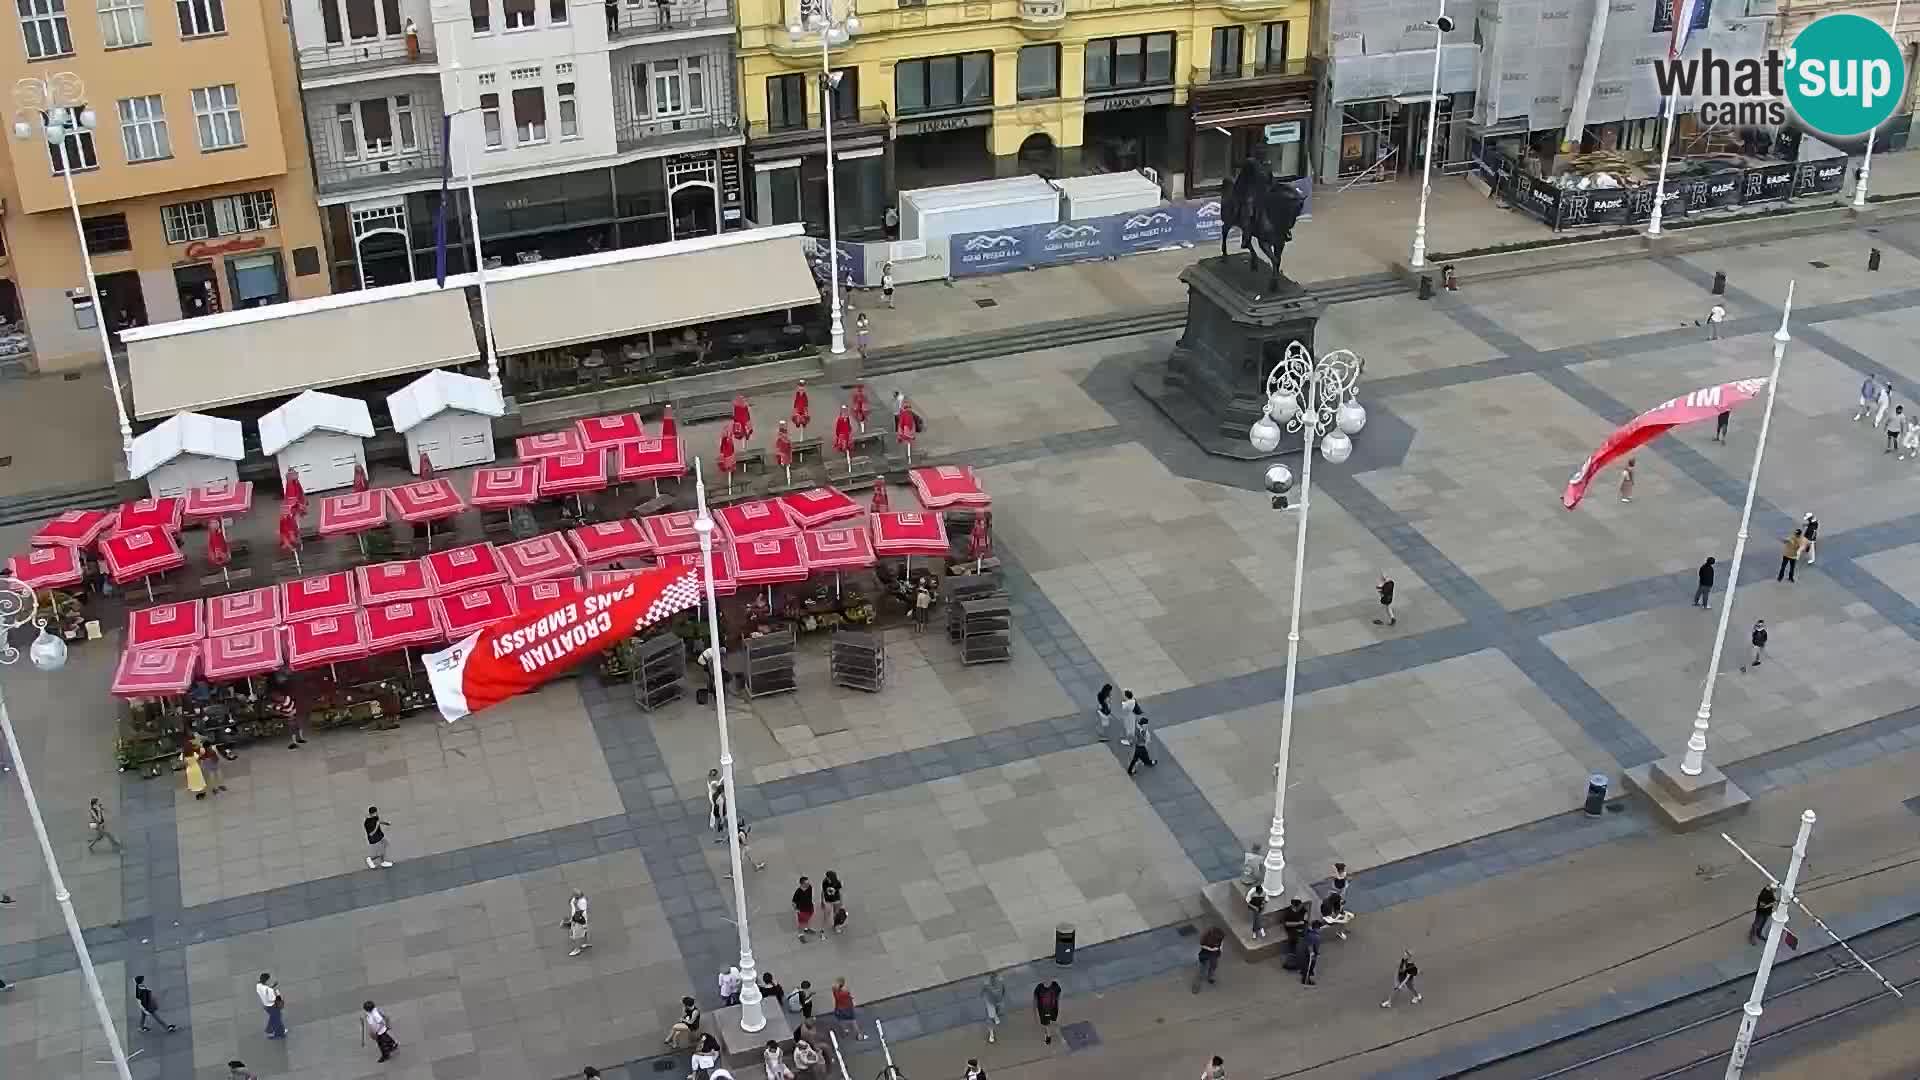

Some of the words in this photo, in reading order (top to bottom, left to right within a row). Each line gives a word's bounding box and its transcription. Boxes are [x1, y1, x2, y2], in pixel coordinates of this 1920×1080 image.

[583, 583, 636, 615] FANS
[492, 603, 578, 660] EMBASSY
[519, 611, 612, 673] CROATIAN
